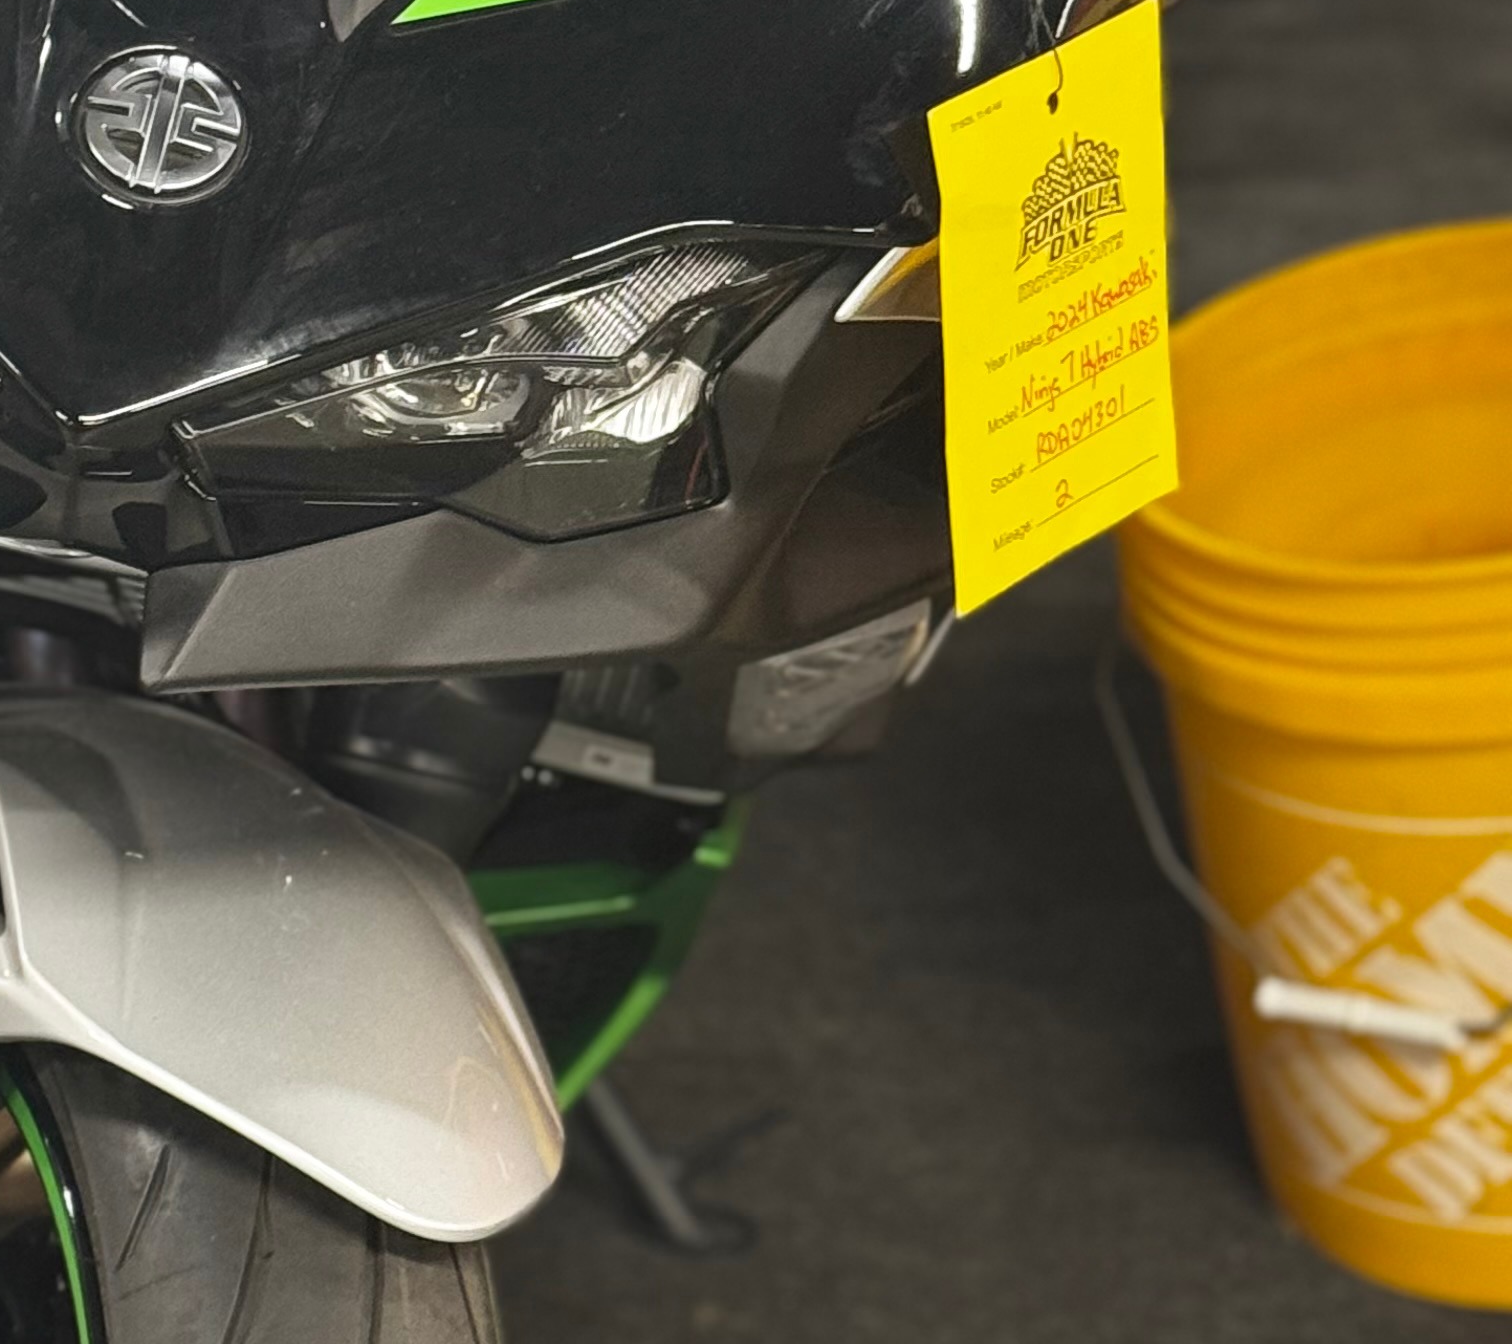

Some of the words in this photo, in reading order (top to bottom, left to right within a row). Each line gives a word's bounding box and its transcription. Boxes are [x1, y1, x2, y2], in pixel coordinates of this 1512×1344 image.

[1021, 180, 1121, 257] FORMULA
[1049, 220, 1097, 262] ONE
[984, 352, 1009, 374] Year
[1046, 290, 1088, 342] 2024
[1060, 349, 1075, 383] 7
[1080, 325, 1124, 390] Hybrid
[1128, 314, 1160, 352] ABS
[1036, 383, 1125, 464] RDA04301
[1054, 478, 1074, 508] 2
